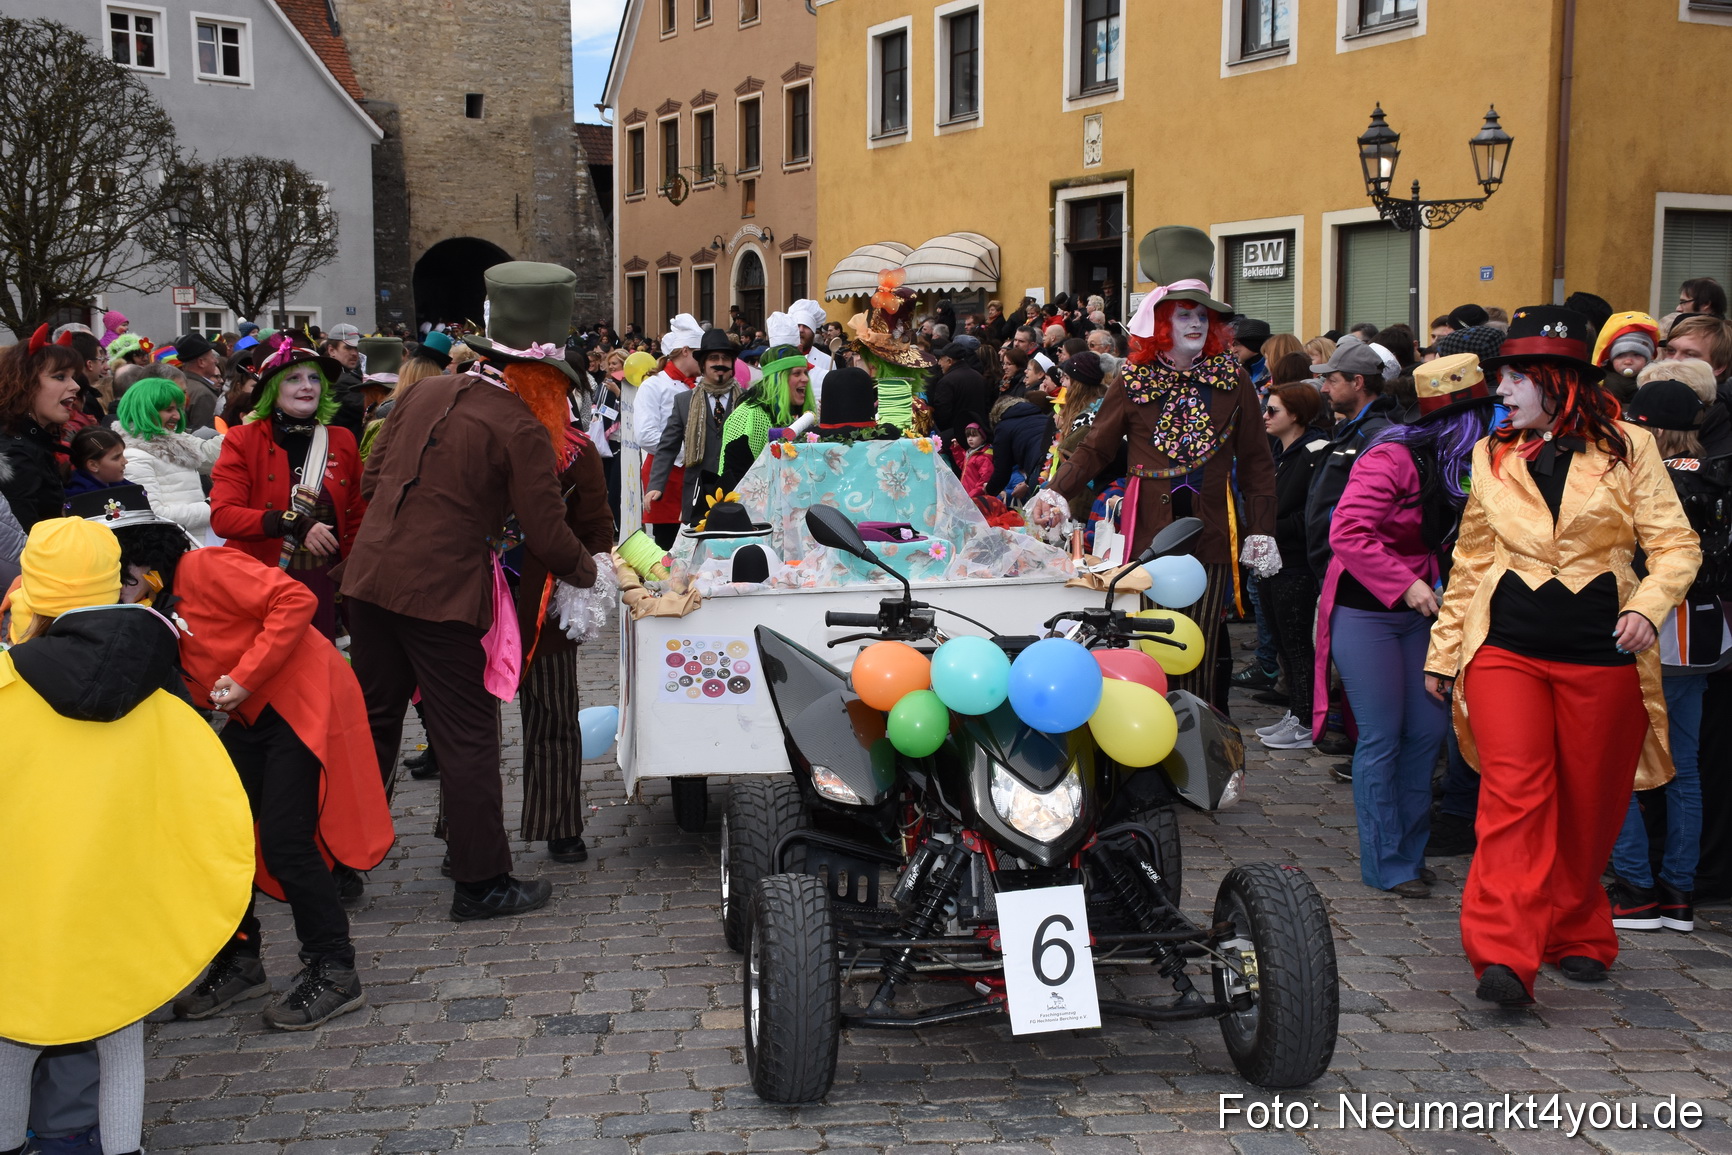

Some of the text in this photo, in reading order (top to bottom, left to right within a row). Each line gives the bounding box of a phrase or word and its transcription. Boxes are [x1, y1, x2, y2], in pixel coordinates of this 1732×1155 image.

[1245, 241, 1282, 263] BW
[1243, 266, 1283, 278] Bekleidung
[1031, 914, 1075, 987] 6
